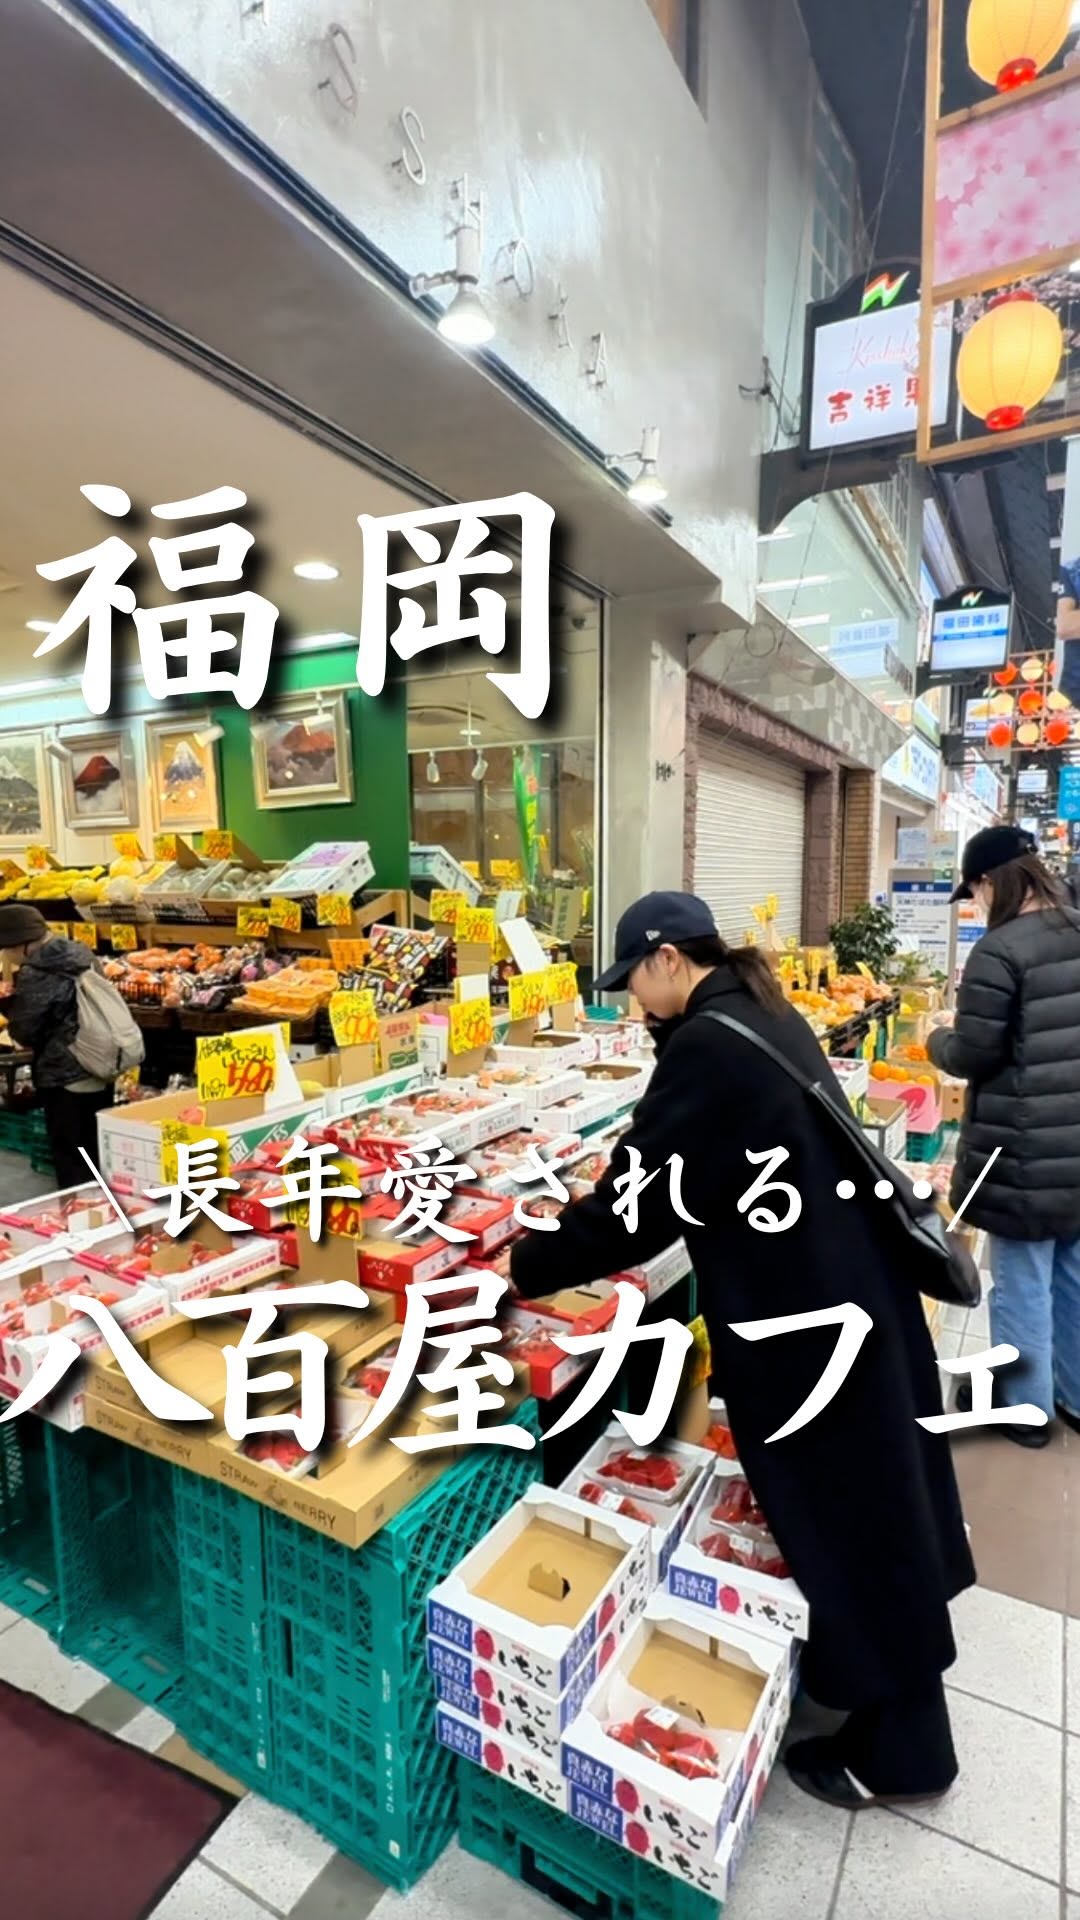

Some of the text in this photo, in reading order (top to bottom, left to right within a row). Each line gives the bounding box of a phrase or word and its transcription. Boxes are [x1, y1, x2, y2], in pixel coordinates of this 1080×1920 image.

[219, 1460, 337, 1531] STRAW BERRY
[673, 1583, 712, 1605] JEWEL
[743, 1601, 801, 1632] いちご
[432, 1621, 469, 1648] JEWEL
[432, 1660, 469, 1690] JEWEL
[498, 1649, 553, 1689] いちご
[440, 1687, 476, 1716] JEWEL
[498, 1689, 552, 1729] いちご
[441, 1731, 479, 1760] JEWEL
[505, 1718, 559, 1758] いちご
[507, 1762, 563, 1803] いちご
[566, 1766, 609, 1798] JEWEL
[575, 1806, 618, 1841] JEWEL
[643, 1803, 708, 1851] いちご
[653, 1844, 720, 1892] いちご
